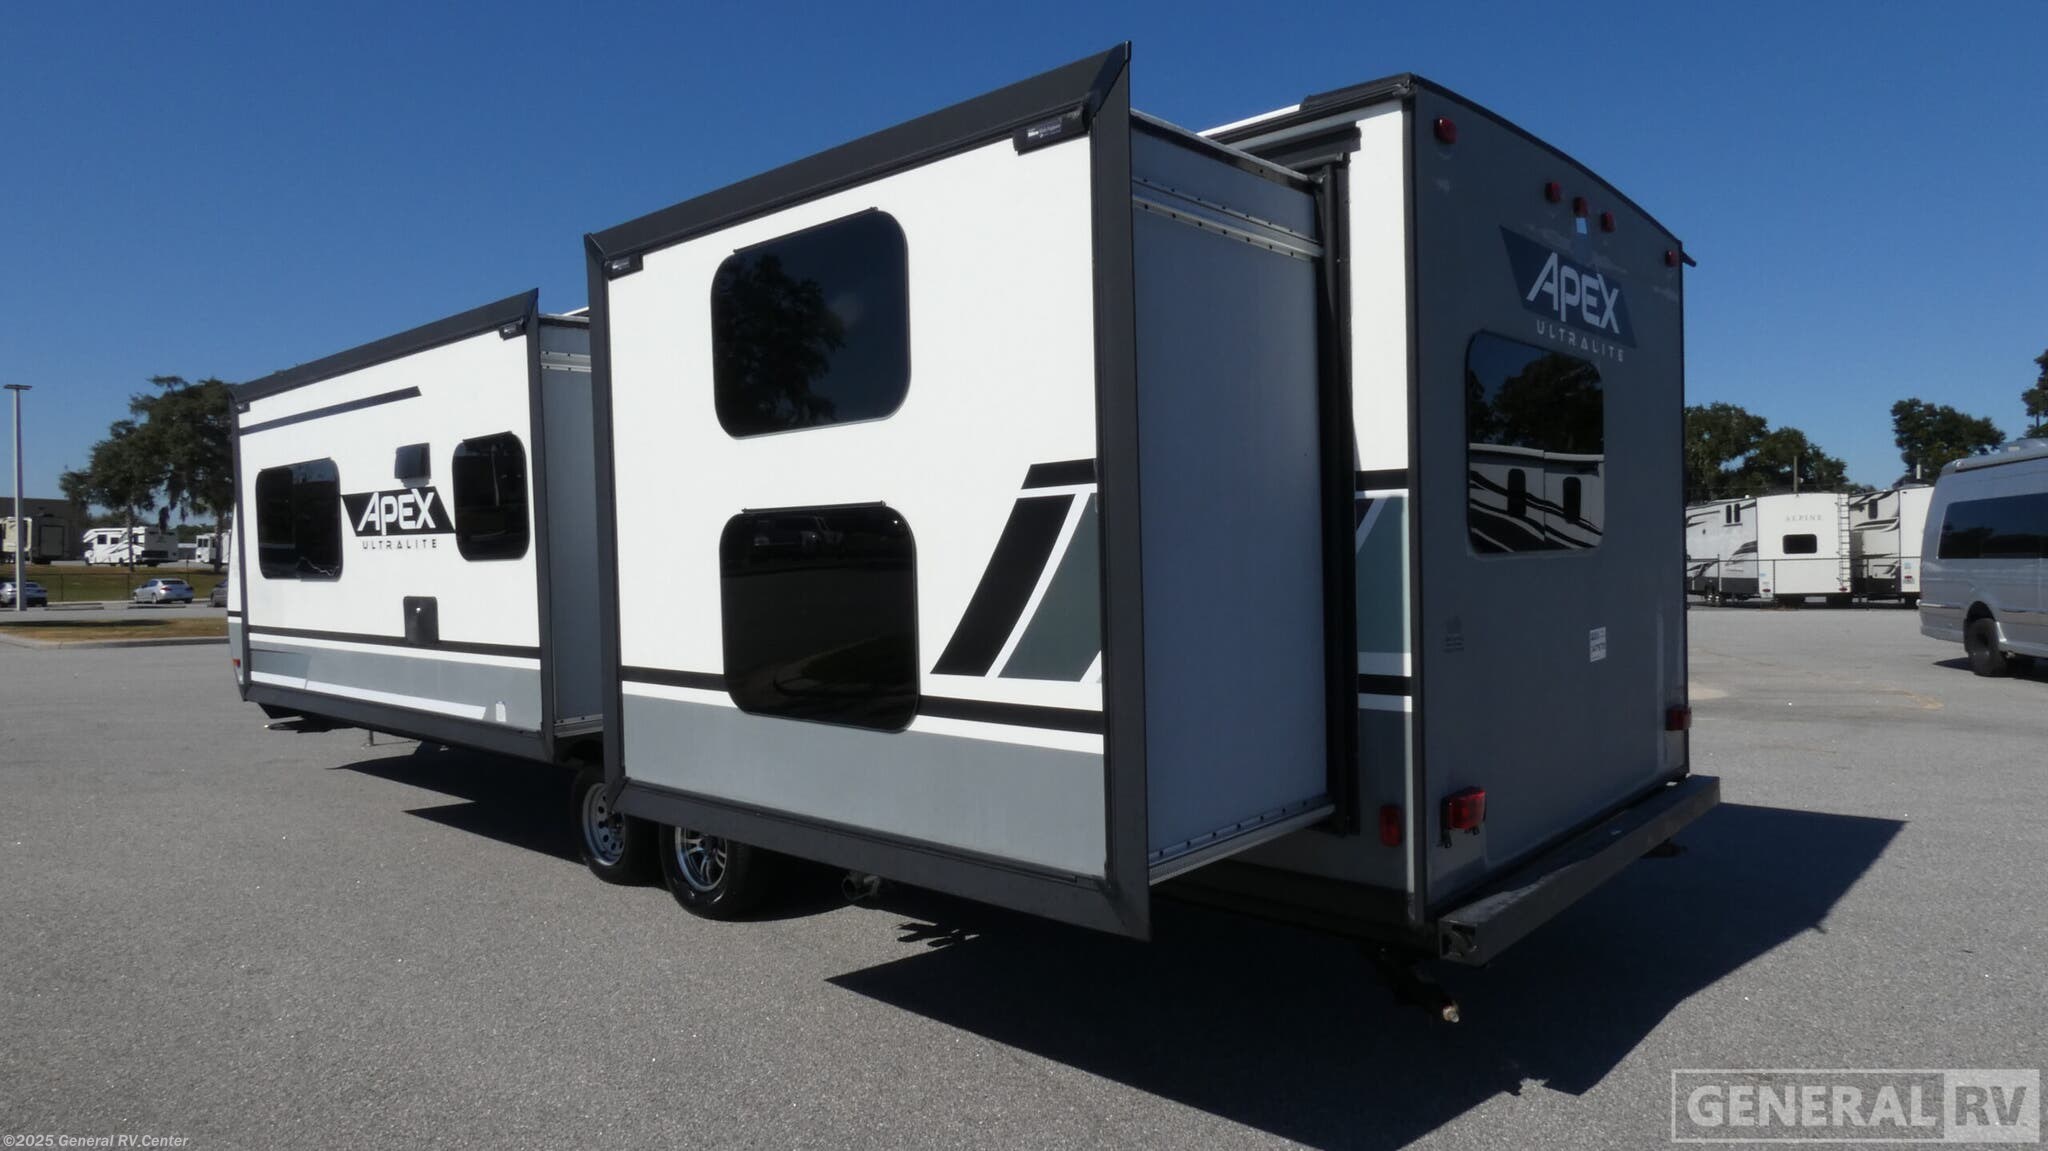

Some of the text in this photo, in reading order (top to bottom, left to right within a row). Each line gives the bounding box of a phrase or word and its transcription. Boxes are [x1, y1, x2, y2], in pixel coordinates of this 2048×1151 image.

[1526, 252, 1619, 334] APEX
[1536, 319, 1624, 362] ULTRALITE
[357, 488, 436, 536] APEX
[362, 539, 437, 550] ULTRALITE
